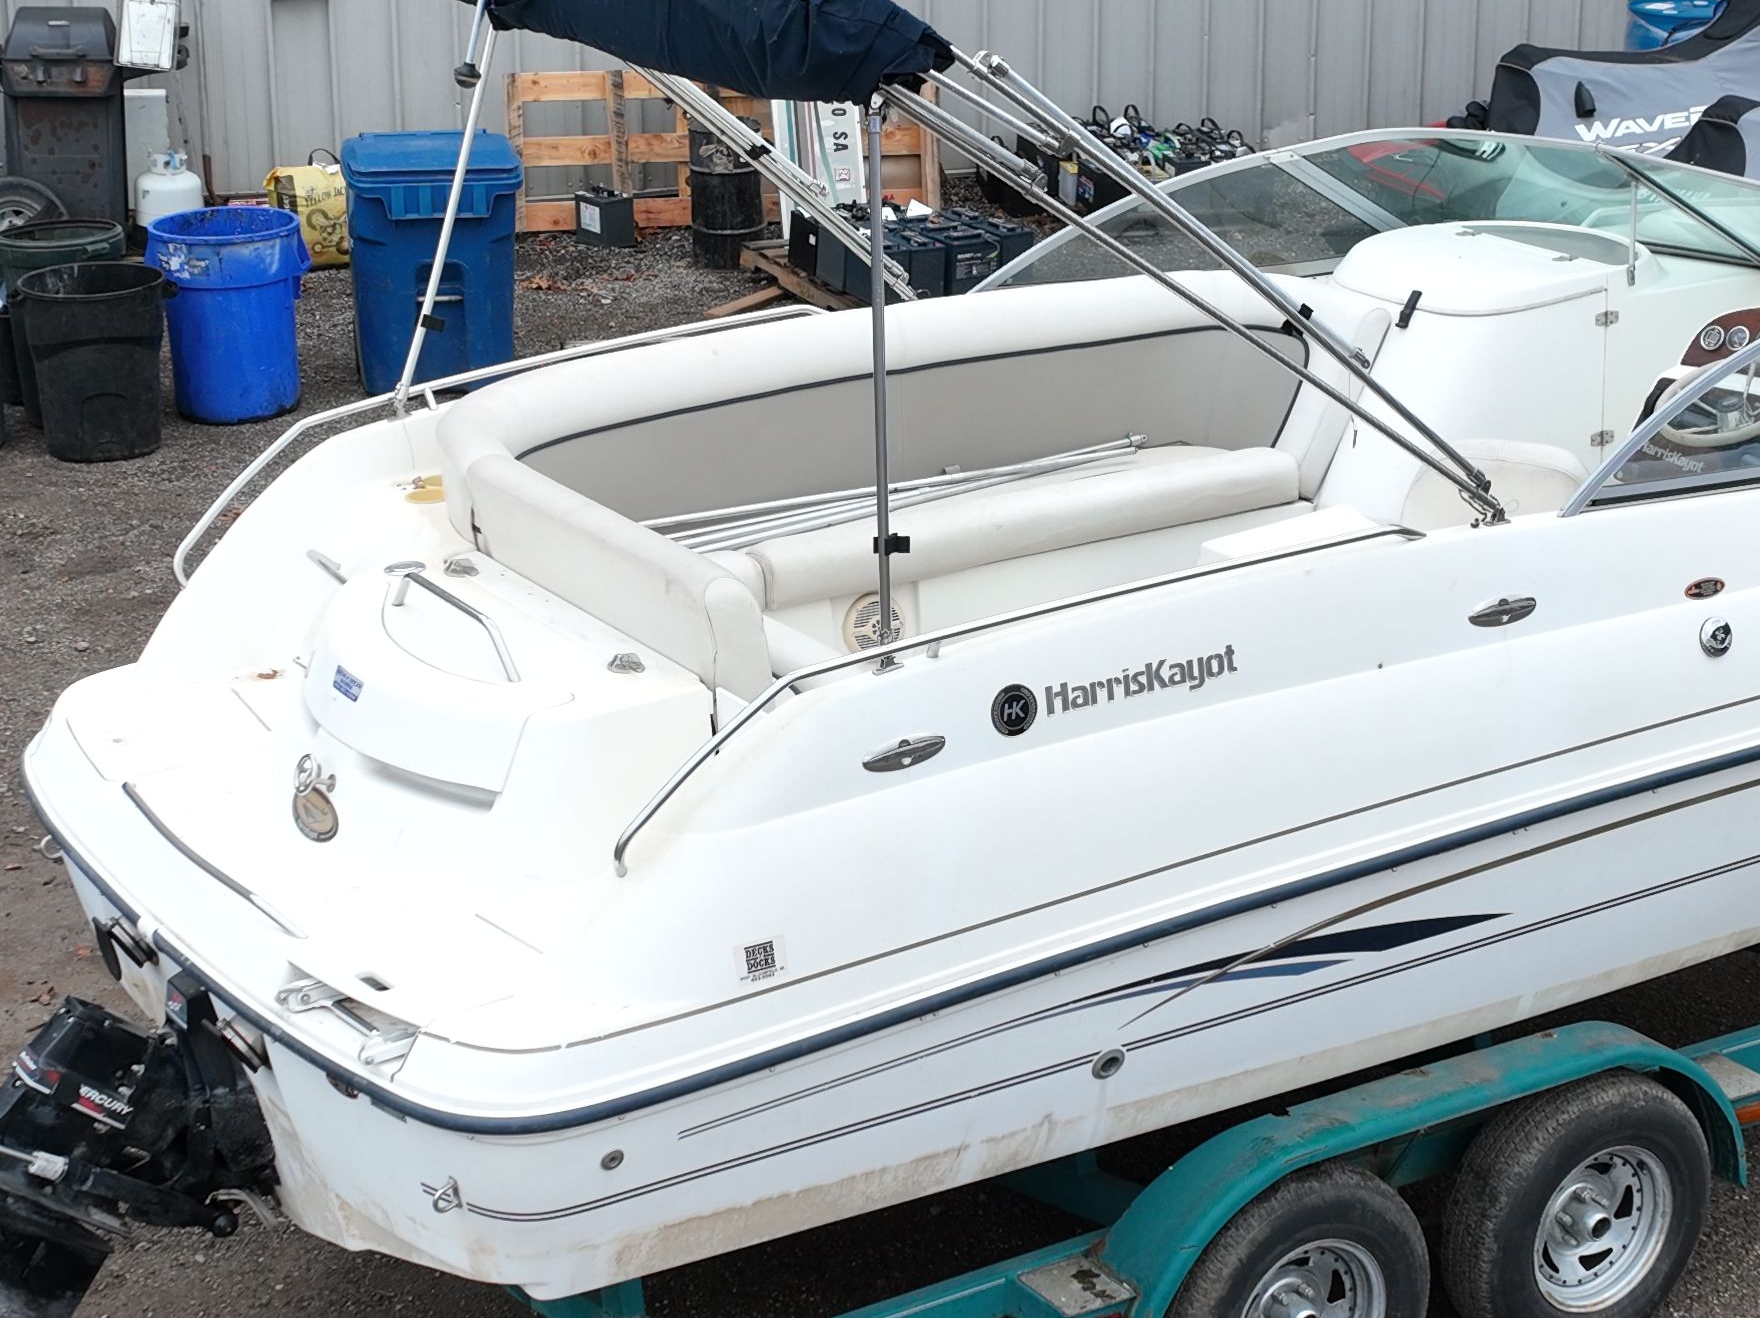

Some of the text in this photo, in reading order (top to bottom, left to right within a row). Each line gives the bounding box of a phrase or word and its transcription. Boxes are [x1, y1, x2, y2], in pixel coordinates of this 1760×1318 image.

[1044, 644, 1239, 718] HarrisKayot
[1003, 699, 1026, 723] HK
[745, 943, 775, 959] DECKS
[747, 955, 776, 971] DOCKS
